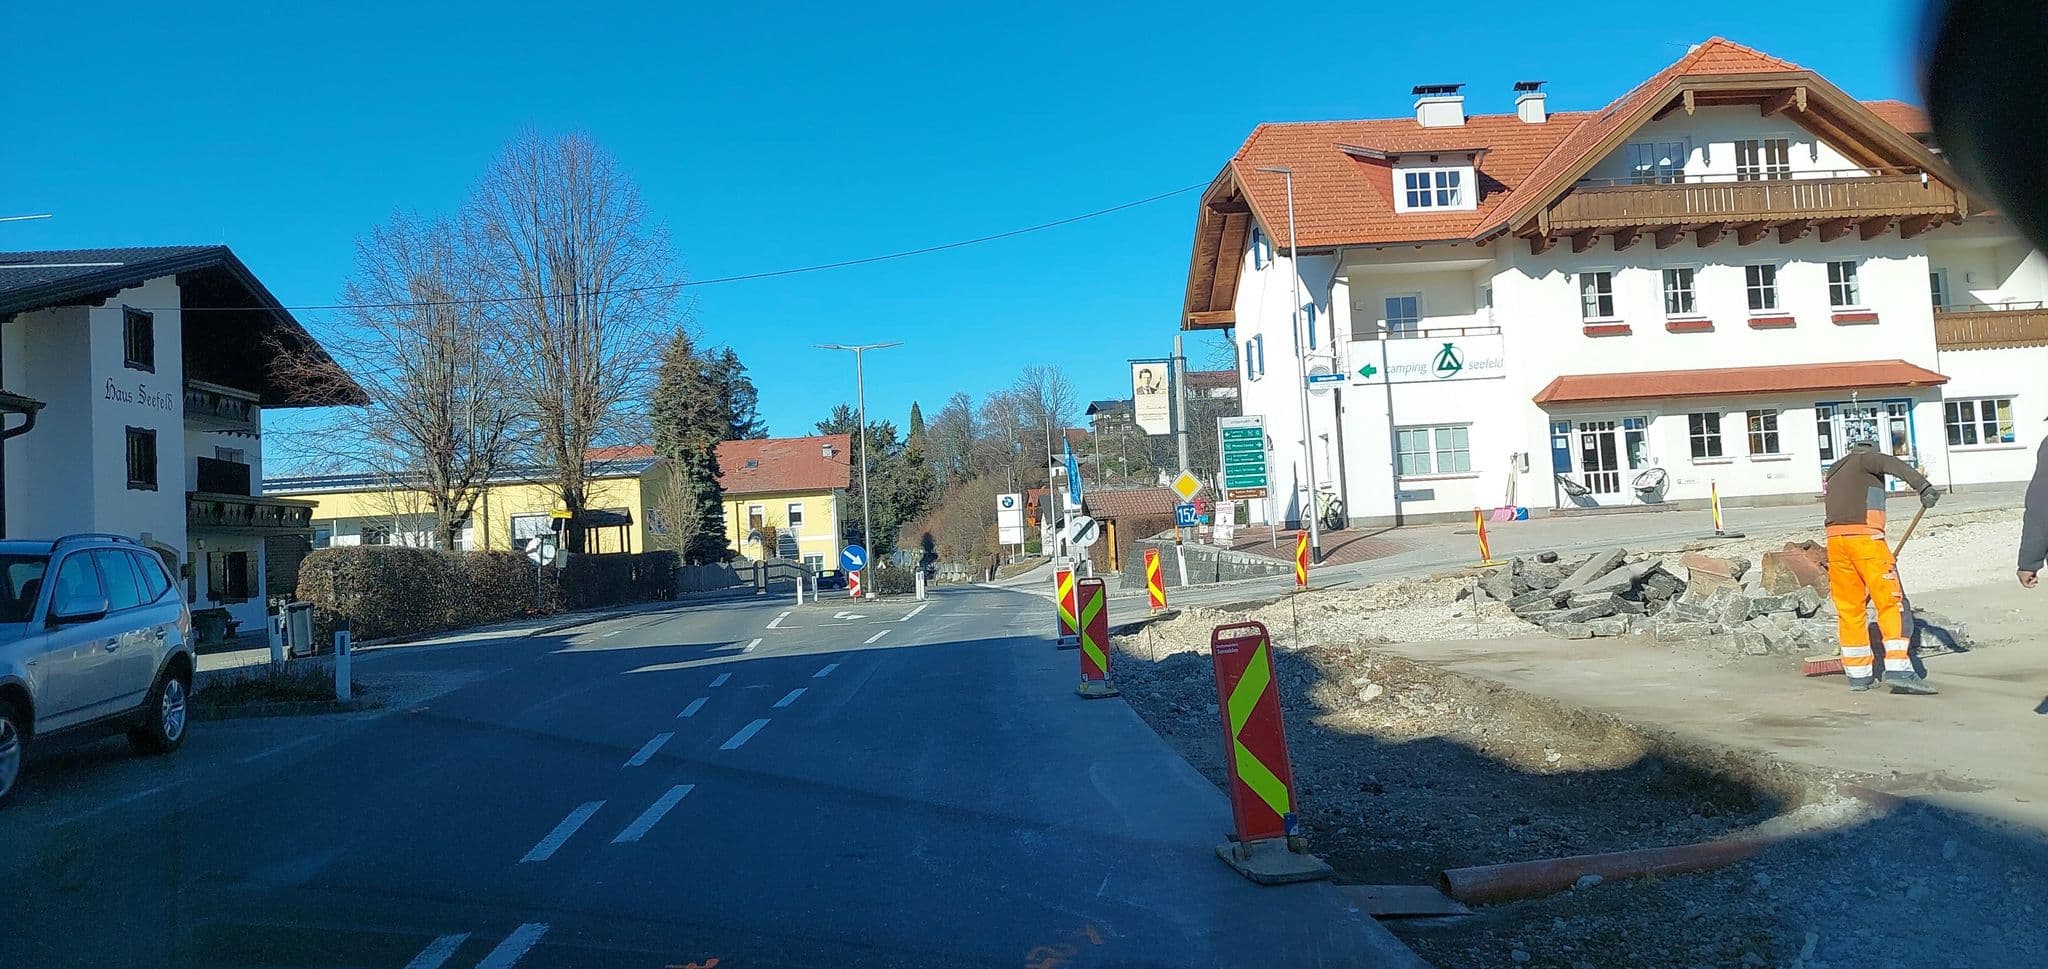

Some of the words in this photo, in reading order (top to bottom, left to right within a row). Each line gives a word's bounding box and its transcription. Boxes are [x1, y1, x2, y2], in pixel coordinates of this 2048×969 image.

[1385, 362, 1427, 375] camping
[1468, 357, 1504, 370] seefeld
[105, 377, 133, 403] Haus
[138, 384, 173, 411] Seefeld
[1178, 508, 1198, 524] 152
